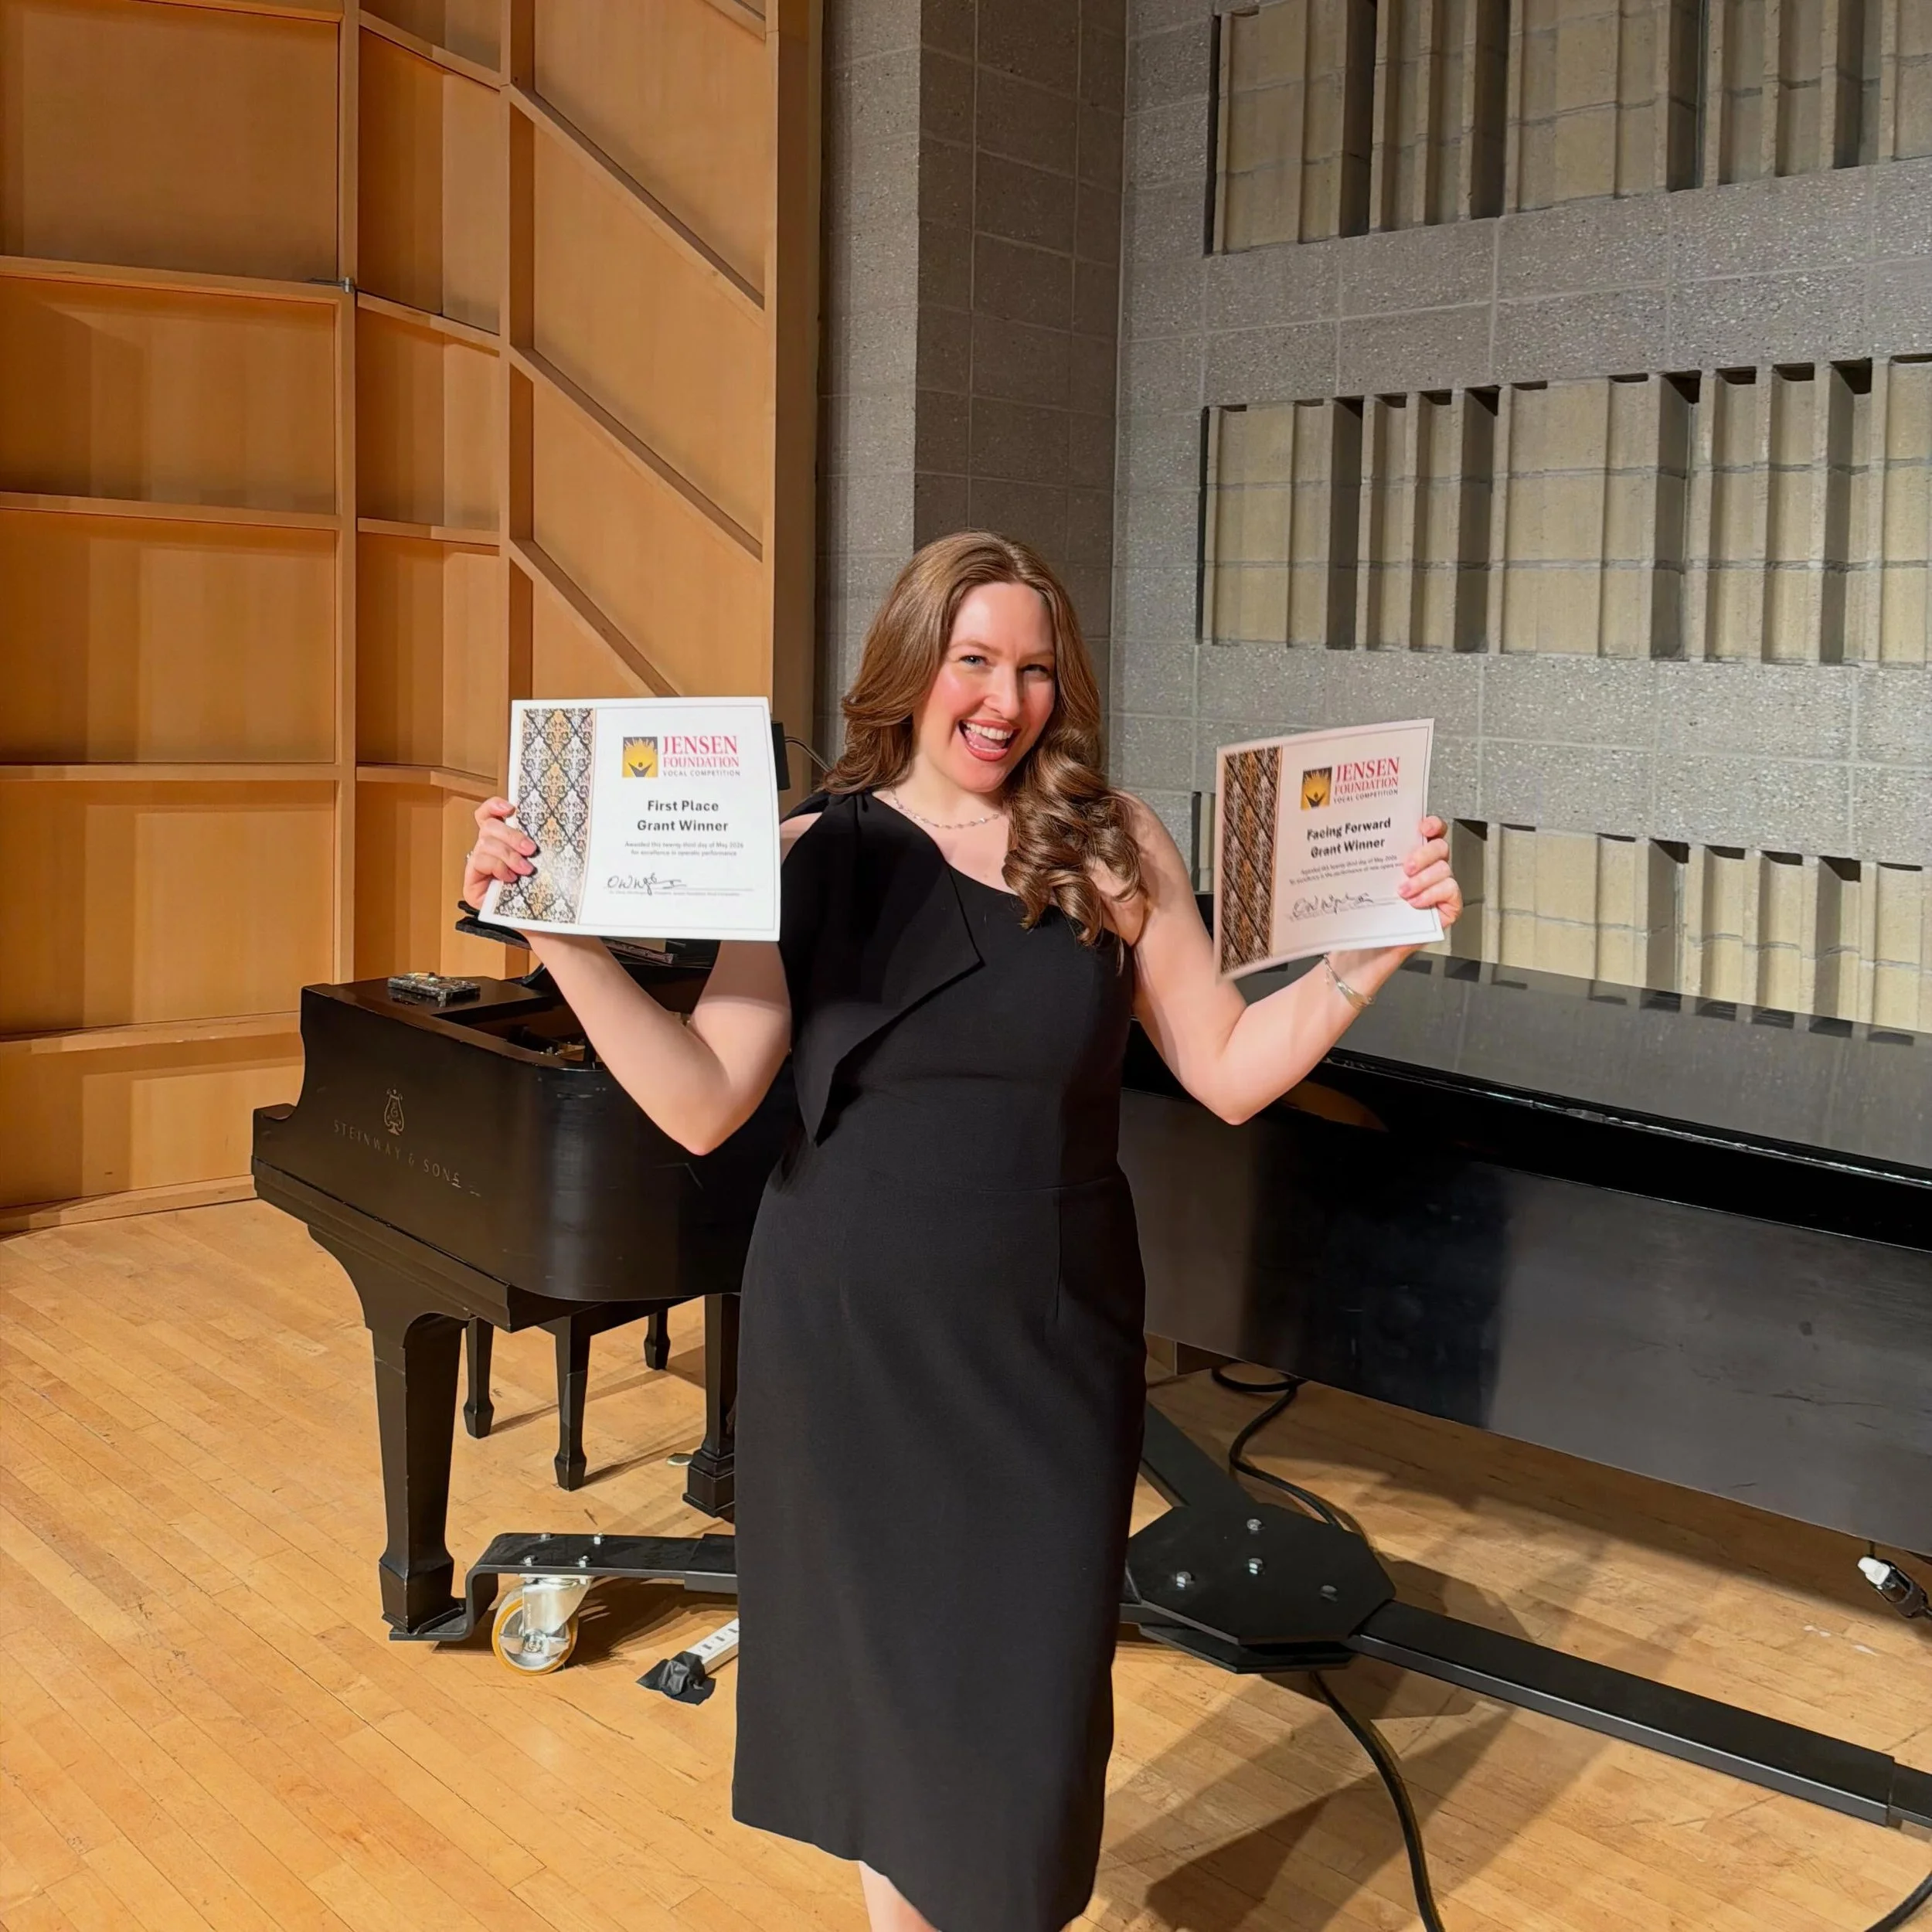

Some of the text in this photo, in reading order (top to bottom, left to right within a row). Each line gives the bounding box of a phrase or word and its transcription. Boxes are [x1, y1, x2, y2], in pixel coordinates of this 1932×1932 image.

[663, 736, 738, 755] JENSEN
[663, 756, 740, 768] FOUNDATION
[1336, 757, 1400, 782] JENSEN
[1335, 776, 1399, 795] FOUNDATION
[1355, 789, 1398, 801] COMPETITION
[648, 800, 719, 811] First Place
[637, 820, 729, 832] Grant Winner
[1306, 818, 1391, 841] Facing Forward
[1310, 838, 1386, 859] Grant Winner
[334, 1120, 401, 1160] STEINWAY
[423, 1158, 461, 1185] SONS
